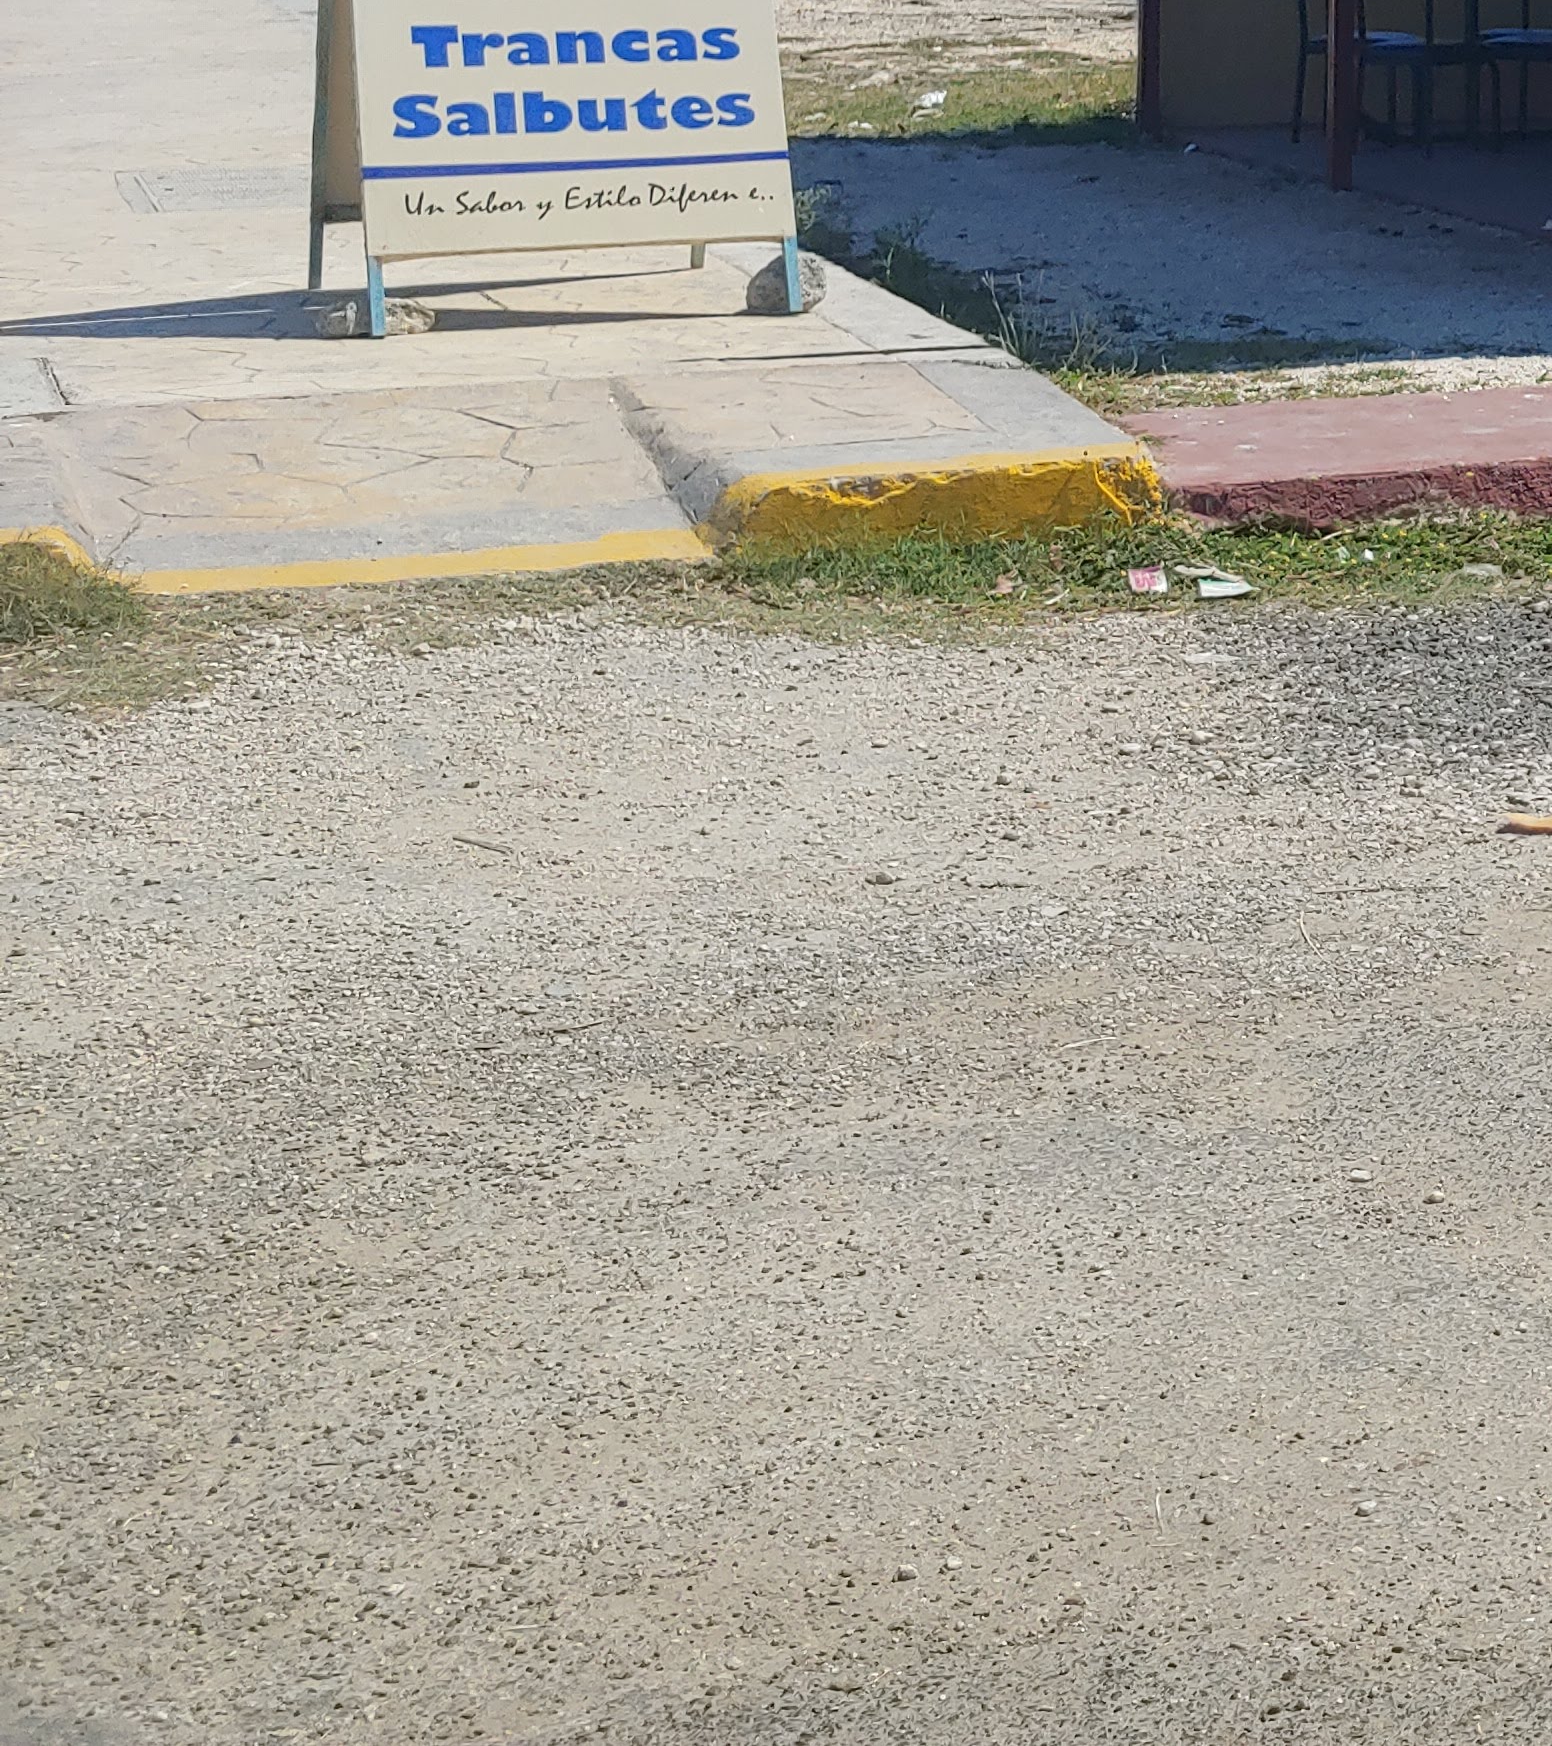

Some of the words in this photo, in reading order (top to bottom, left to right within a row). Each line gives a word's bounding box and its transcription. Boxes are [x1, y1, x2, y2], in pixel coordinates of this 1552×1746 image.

[410, 25, 741, 68] Trancas
[393, 88, 755, 139] Salbutes
[405, 191, 445, 216] Un
[455, 191, 526, 215] Sabor
[537, 201, 554, 220] y
[565, 186, 642, 210] Estilo
